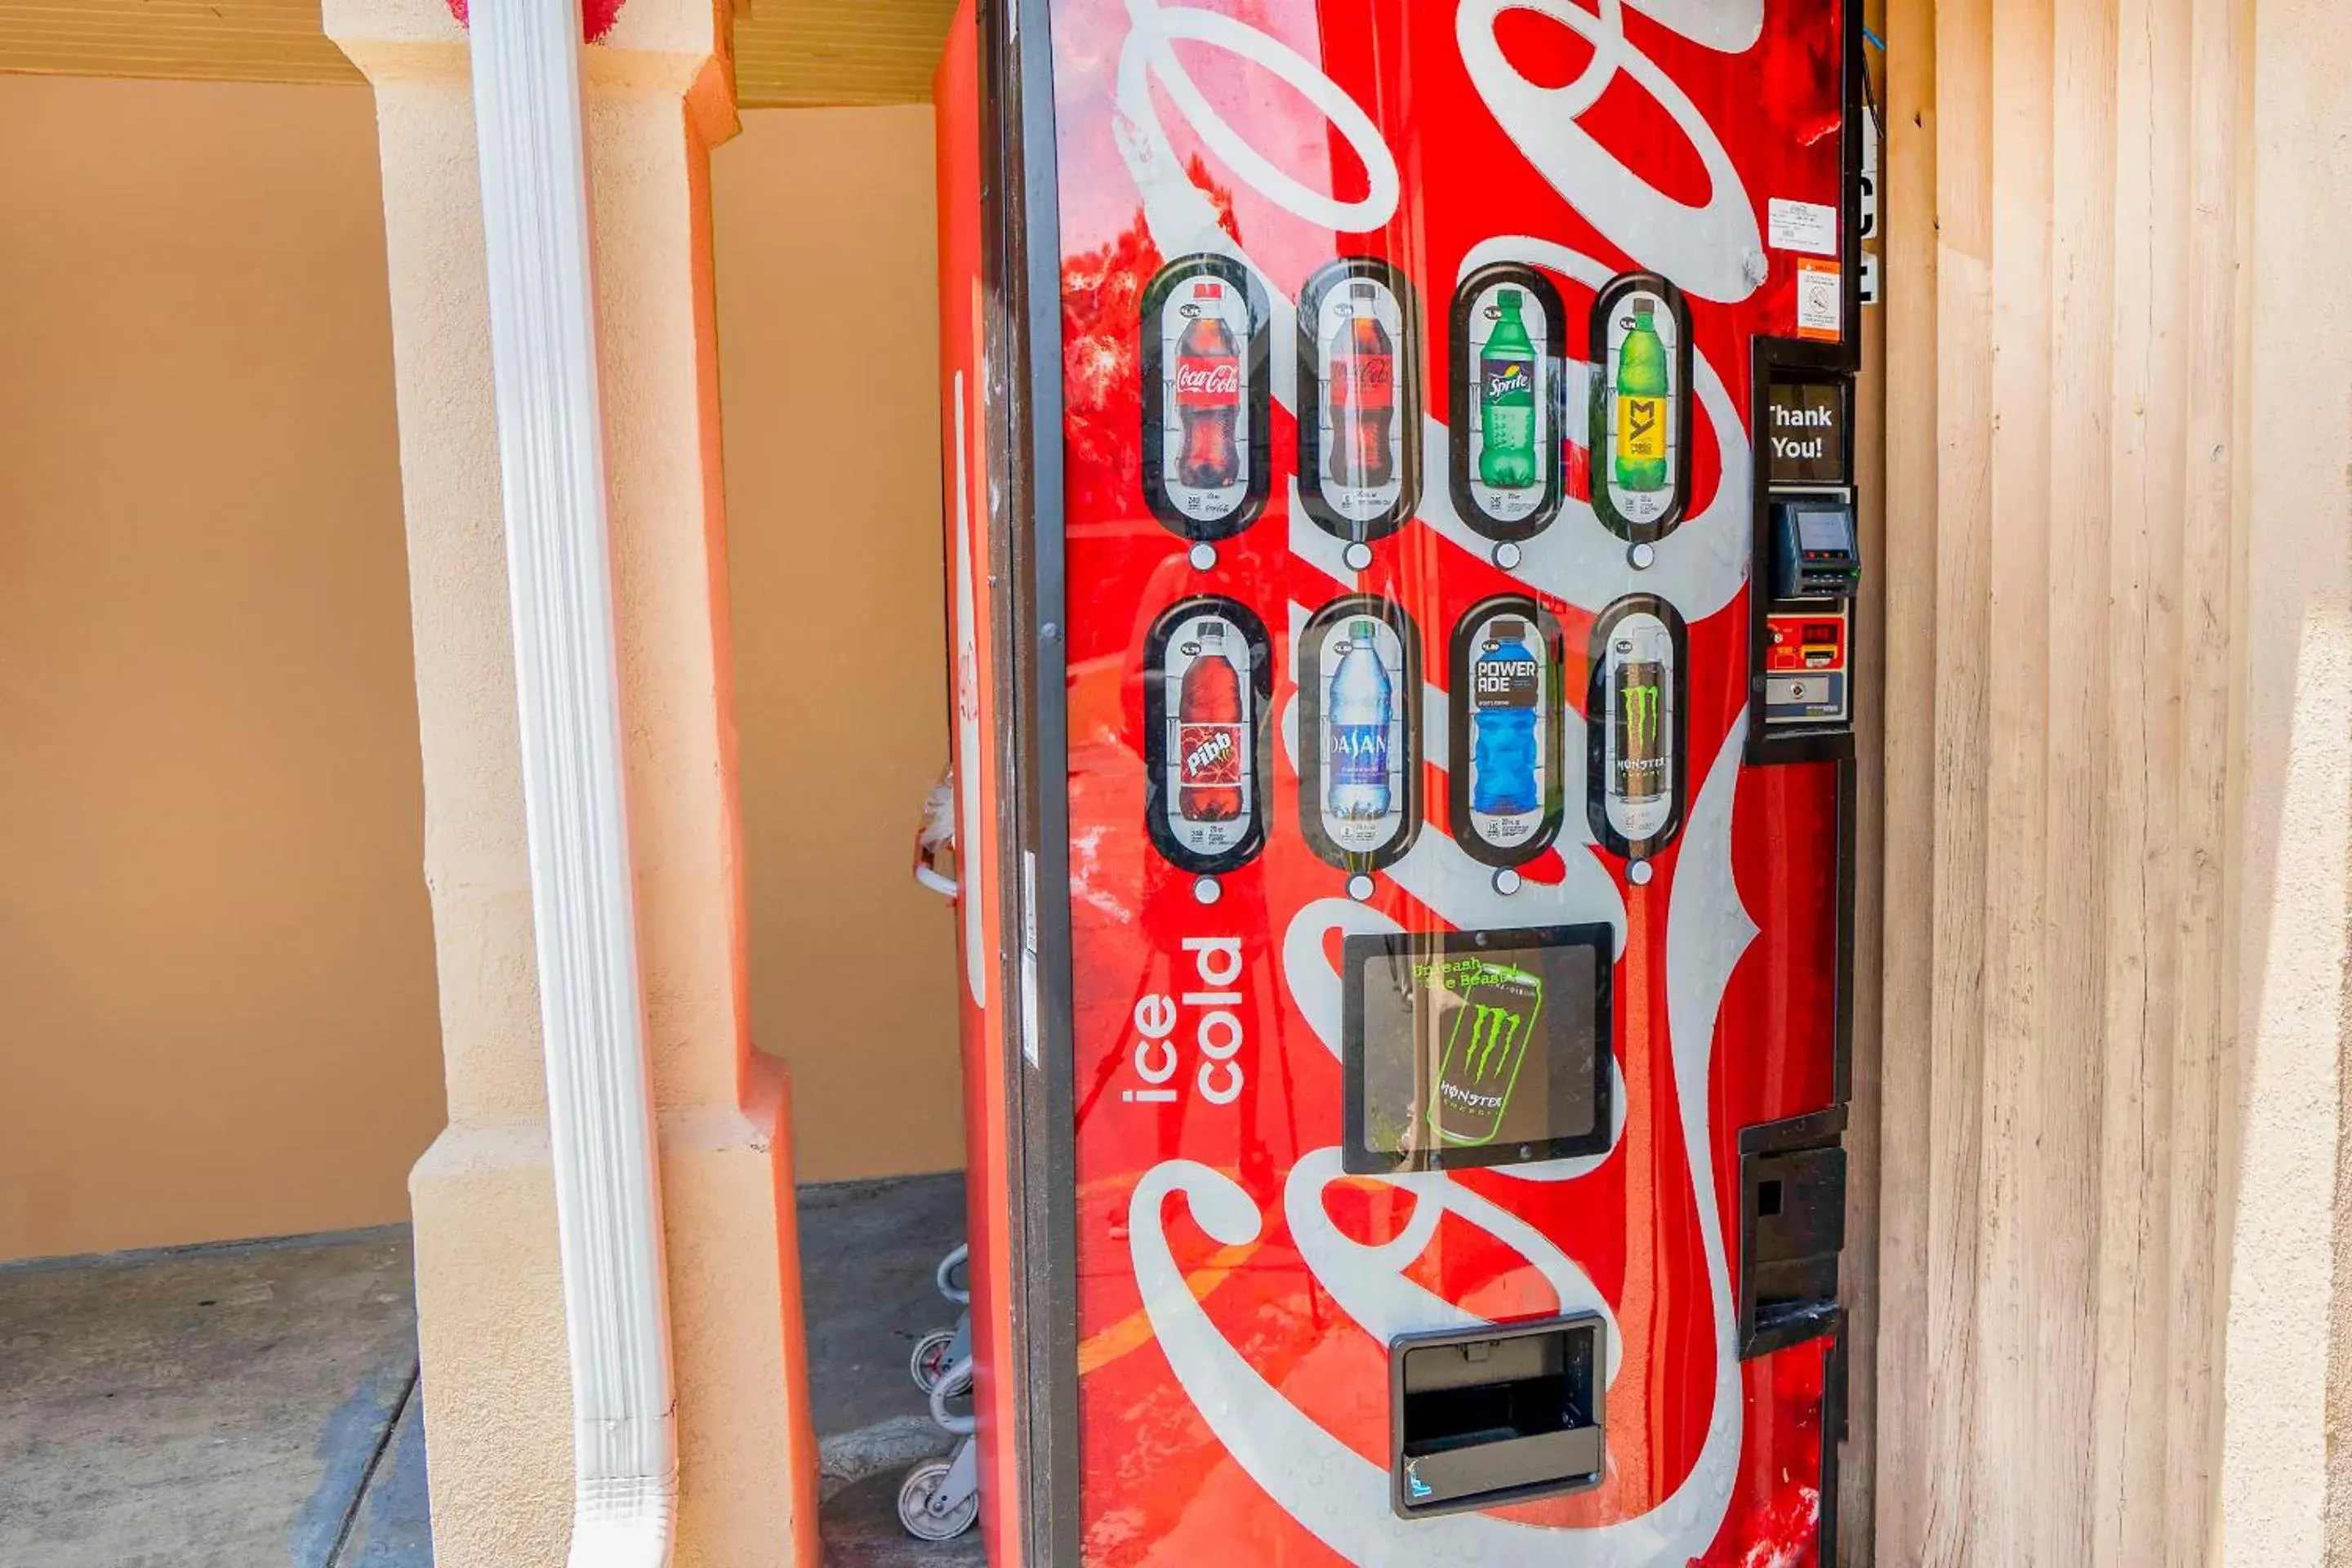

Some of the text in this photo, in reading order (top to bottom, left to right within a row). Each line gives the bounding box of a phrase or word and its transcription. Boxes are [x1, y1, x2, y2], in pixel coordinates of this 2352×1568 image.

[1178, 364, 1238, 393] Coca-Cola
[1490, 373, 1529, 398] Sprite
[1771, 437, 1823, 458] You!
[1477, 661, 1535, 677] POWER
[1477, 677, 1511, 693] ADE
[1187, 732, 1232, 777] Pibb
[1182, 938, 1245, 1104] cold
[1121, 994, 1178, 1102] ice
